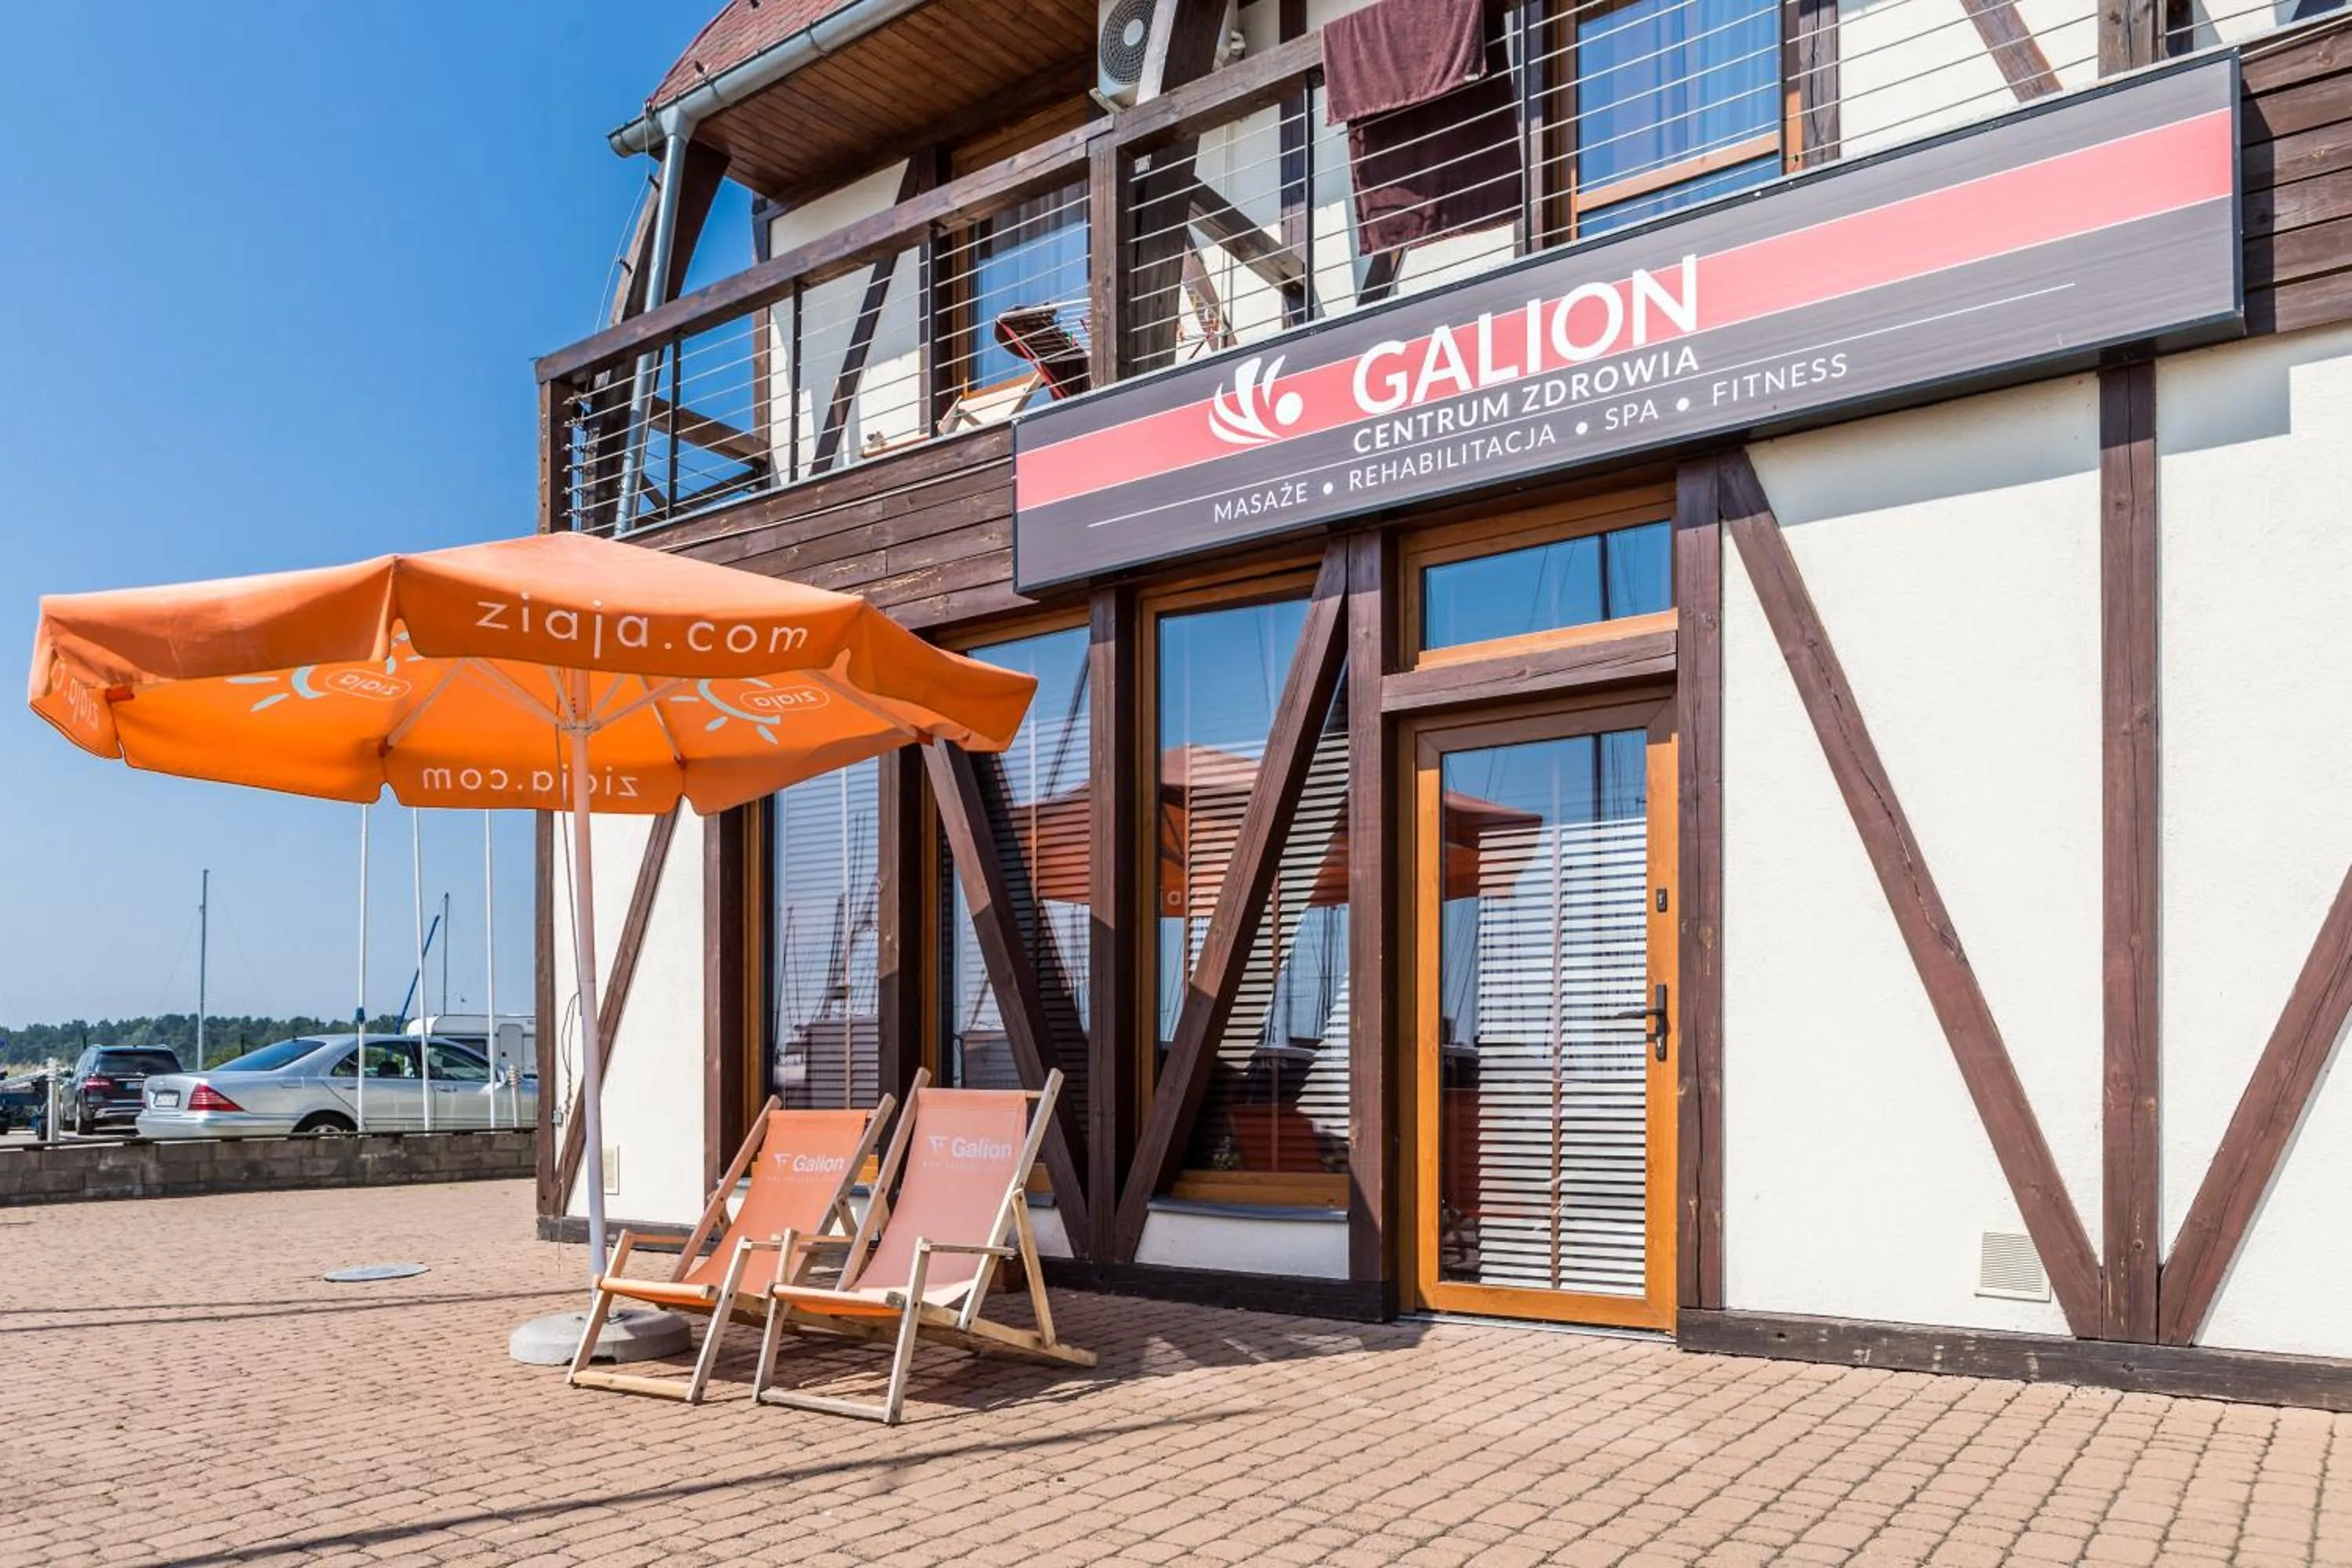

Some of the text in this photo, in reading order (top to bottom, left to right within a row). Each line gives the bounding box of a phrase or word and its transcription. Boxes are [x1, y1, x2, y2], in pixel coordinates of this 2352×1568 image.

[1352, 254, 1697, 416] GALION
[1214, 353, 1848, 524] MASAŻE REHABILITACJA SPA FITNESS
[1352, 346, 1700, 455] CENTRUM ZDROWIA
[476, 591, 808, 659] ziaja.com
[793, 1154, 844, 1172] Galion
[952, 1137, 1012, 1159] Galion
